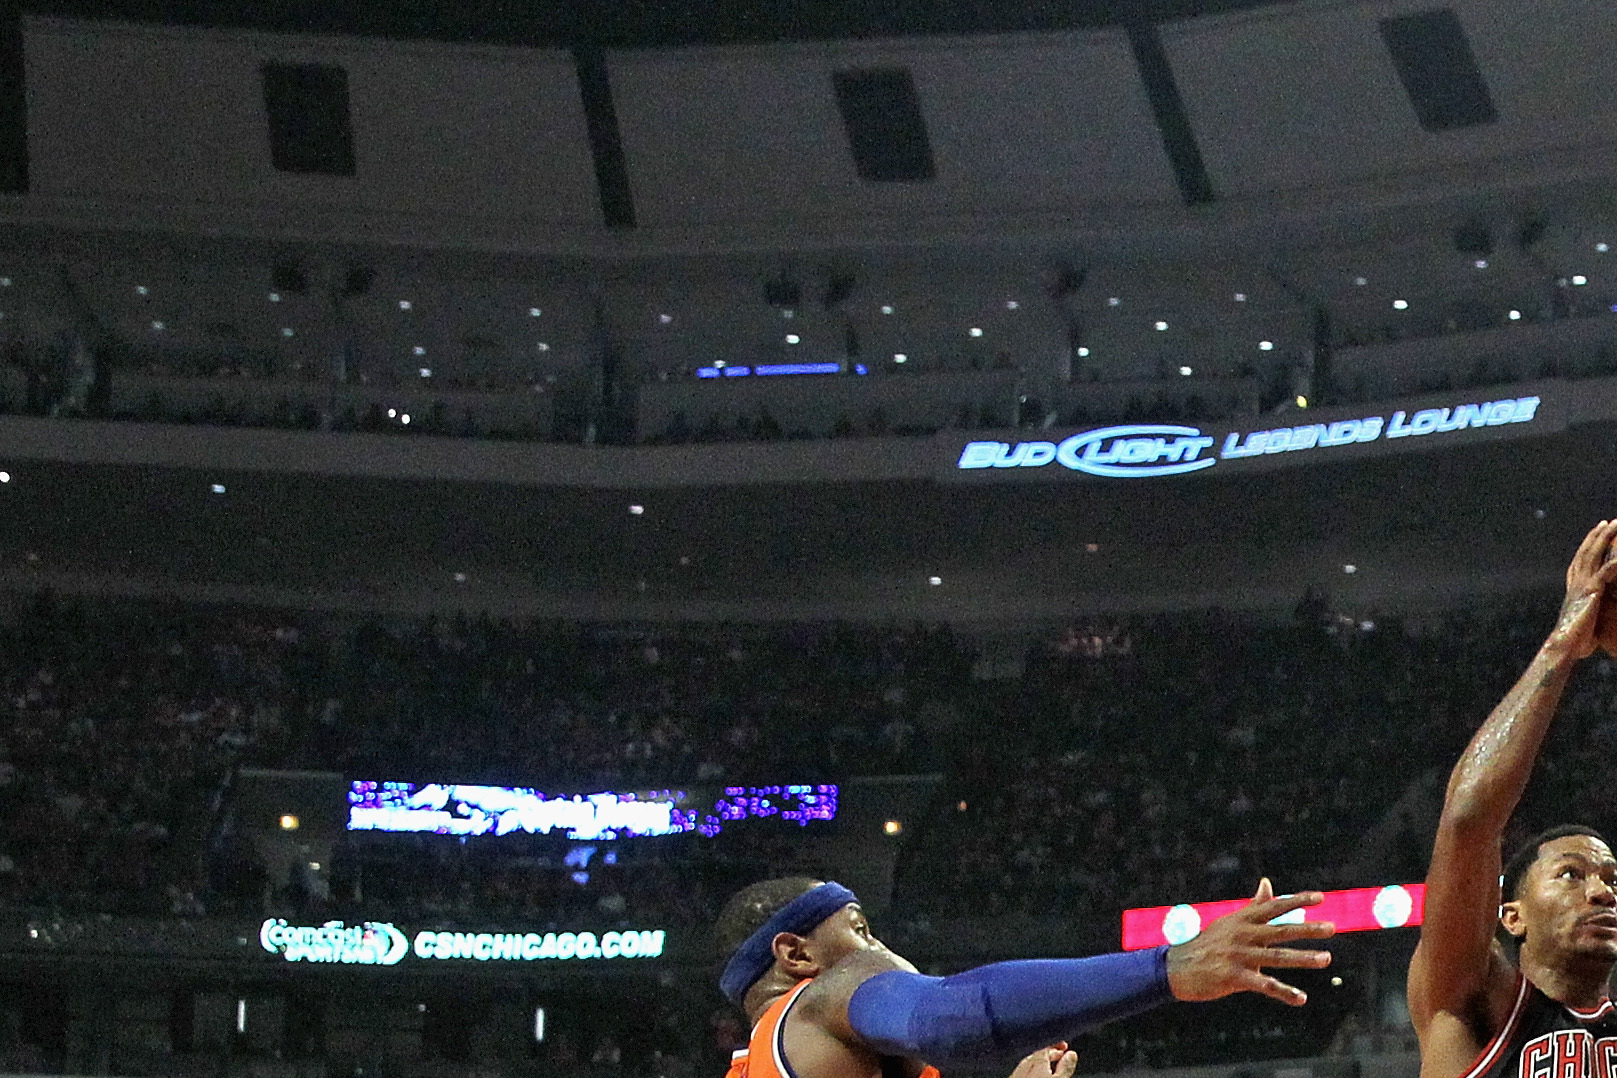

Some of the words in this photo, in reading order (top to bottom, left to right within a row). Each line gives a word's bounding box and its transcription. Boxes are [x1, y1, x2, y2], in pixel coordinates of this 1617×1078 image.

[960, 441, 1056, 469] BUD
[1081, 436, 1214, 463] LIGHT
[1221, 416, 1385, 460] LEGENDS
[1387, 396, 1541, 438] LOUNGE
[414, 931, 666, 960] CSNCHICAGO.COM
